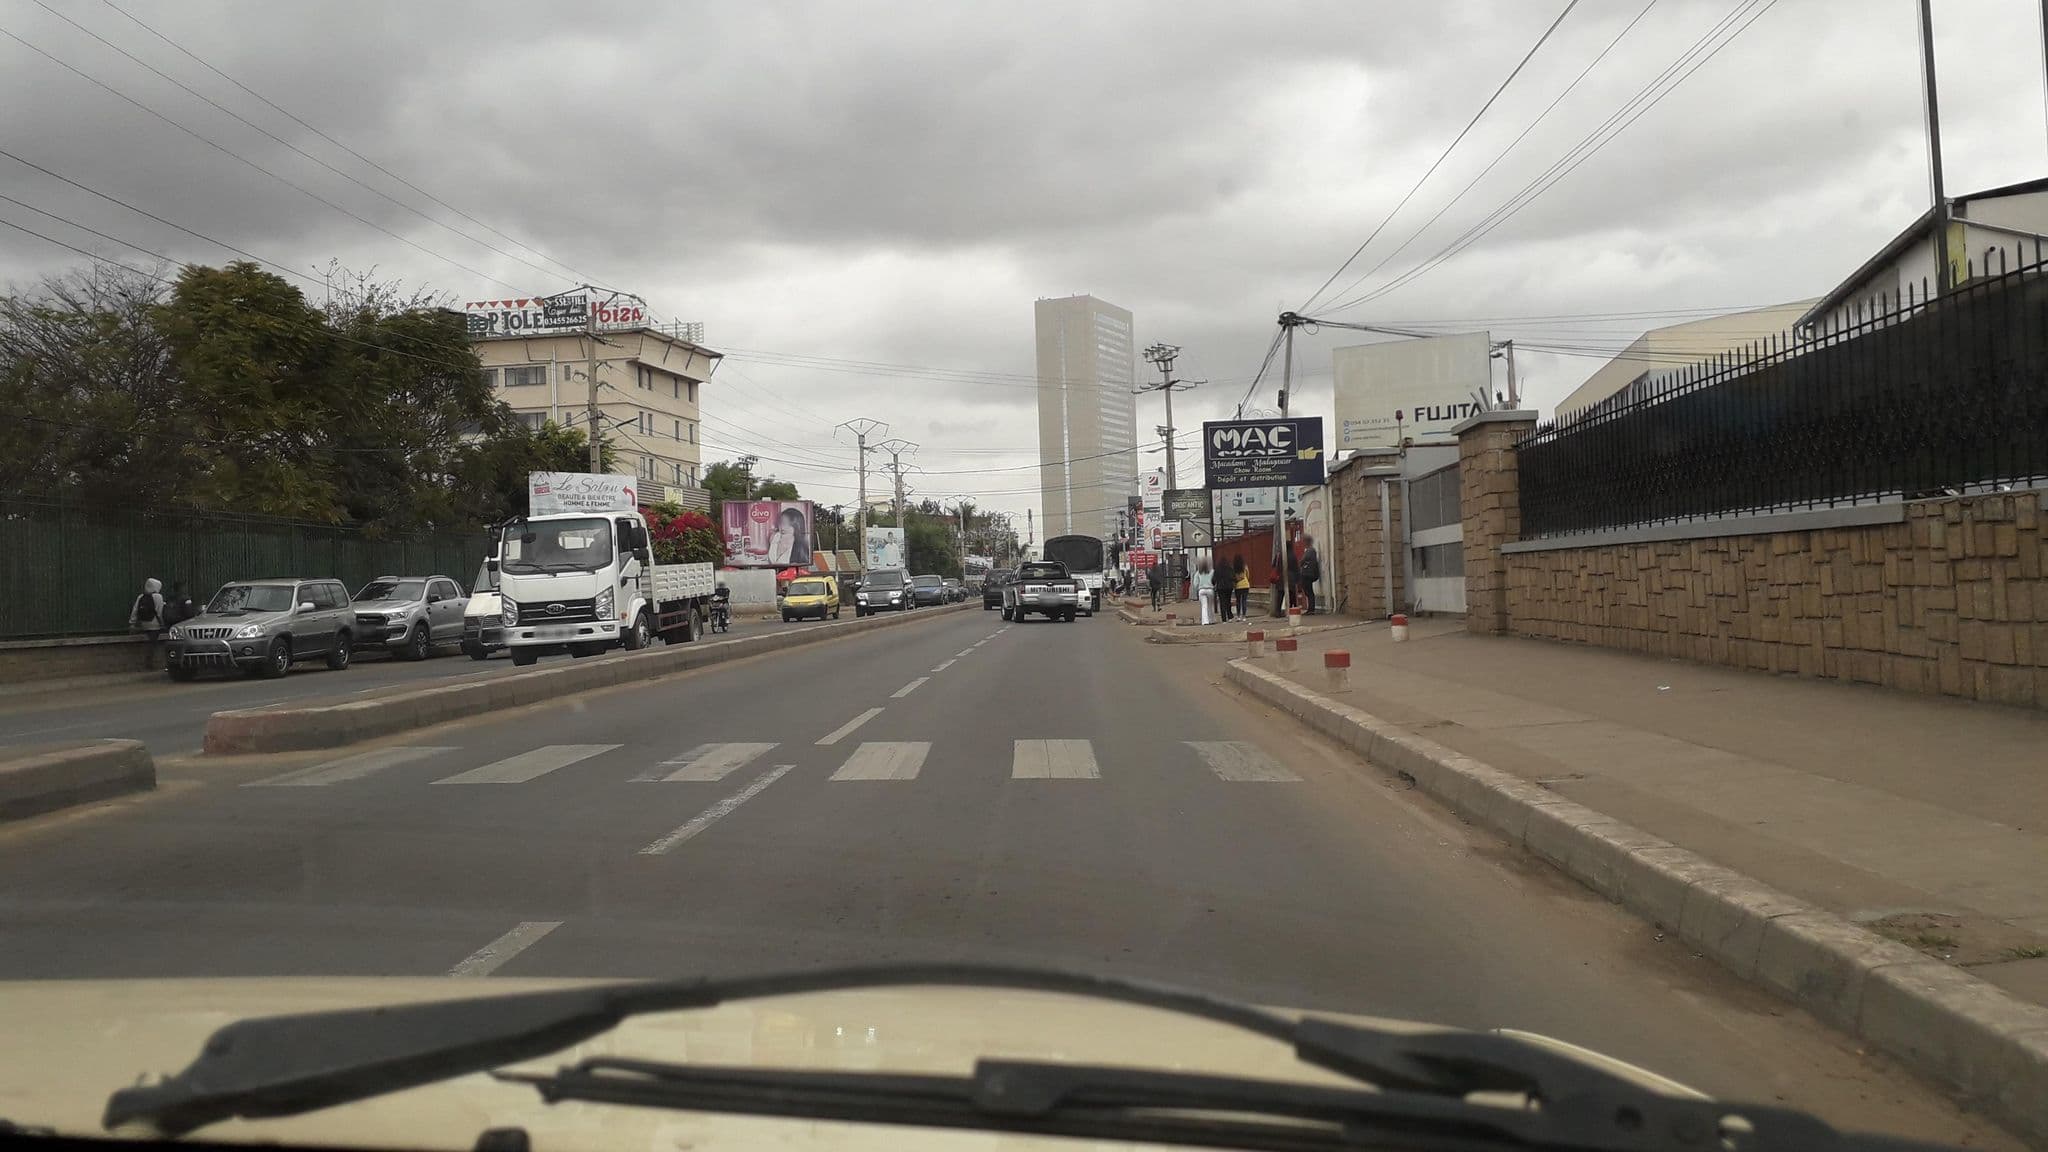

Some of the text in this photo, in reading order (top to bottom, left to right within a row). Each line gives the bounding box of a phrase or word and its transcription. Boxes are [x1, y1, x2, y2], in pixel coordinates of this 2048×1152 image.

[1415, 402, 1482, 422] FUJITA
[1213, 426, 1291, 450] MAC
[1218, 448, 1288, 457] MAD
[751, 506, 770, 517] diva
